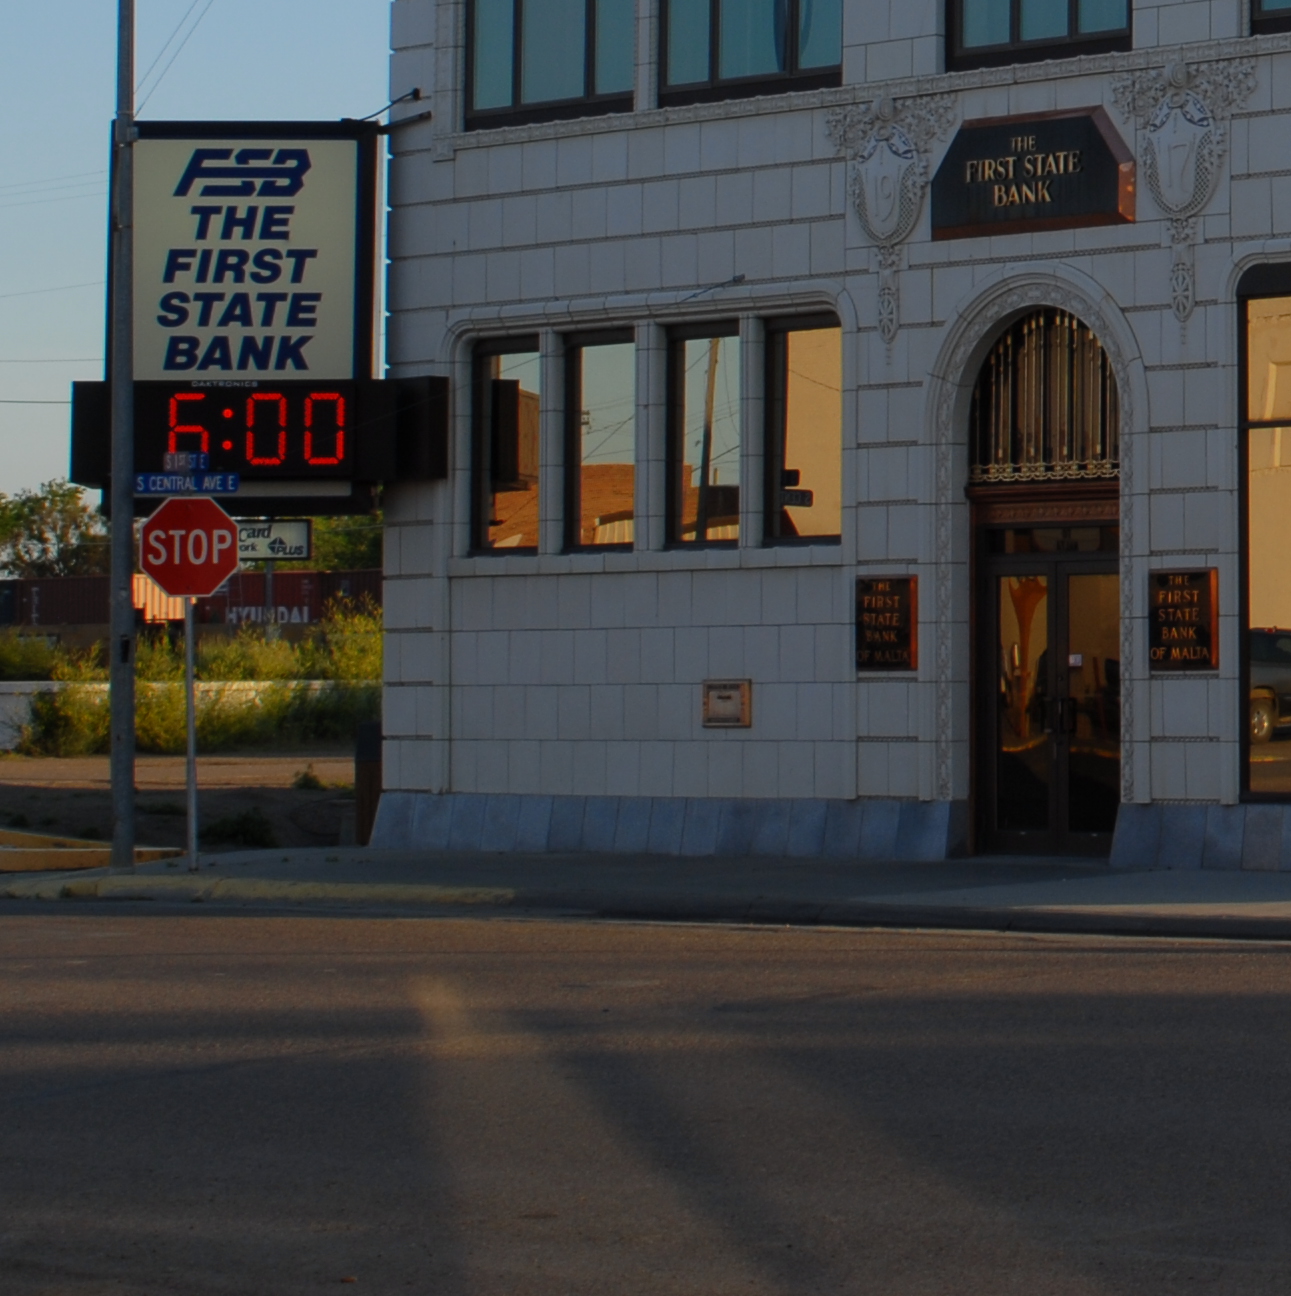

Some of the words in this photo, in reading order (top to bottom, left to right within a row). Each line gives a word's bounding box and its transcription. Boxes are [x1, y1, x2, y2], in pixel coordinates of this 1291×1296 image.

[1010, 135, 1037, 152] THE
[172, 148, 312, 197] FSB
[965, 156, 1018, 183] FIRST
[1024, 150, 1082, 178] STATE
[993, 180, 1052, 206] BANK
[190, 205, 295, 241] THE
[162, 247, 319, 284] FIRST
[156, 291, 322, 327] STATE
[162, 335, 314, 371] BANK
[166, 454, 172, 470] S
[200, 454, 206, 470] E
[136, 477, 144, 491] S
[149, 476, 198, 491] CENTRAL
[203, 476, 223, 491] AVE
[228, 475, 235, 490] E
[147, 529, 232, 566] STOP
[276, 544, 304, 555] PLUS
[871, 581, 891, 592] THE
[1168, 575, 1190, 586] THE
[863, 595, 901, 609] FIRST
[1158, 590, 1200, 603] FIRST
[862, 613, 900, 626] STATE
[1158, 608, 1200, 622] STATE
[865, 630, 898, 642] BANK
[1161, 627, 1197, 640] BANK
[857, 650, 871, 662] OF
[1151, 647, 1167, 660] OF
[1170, 647, 1210, 660] MALTA
